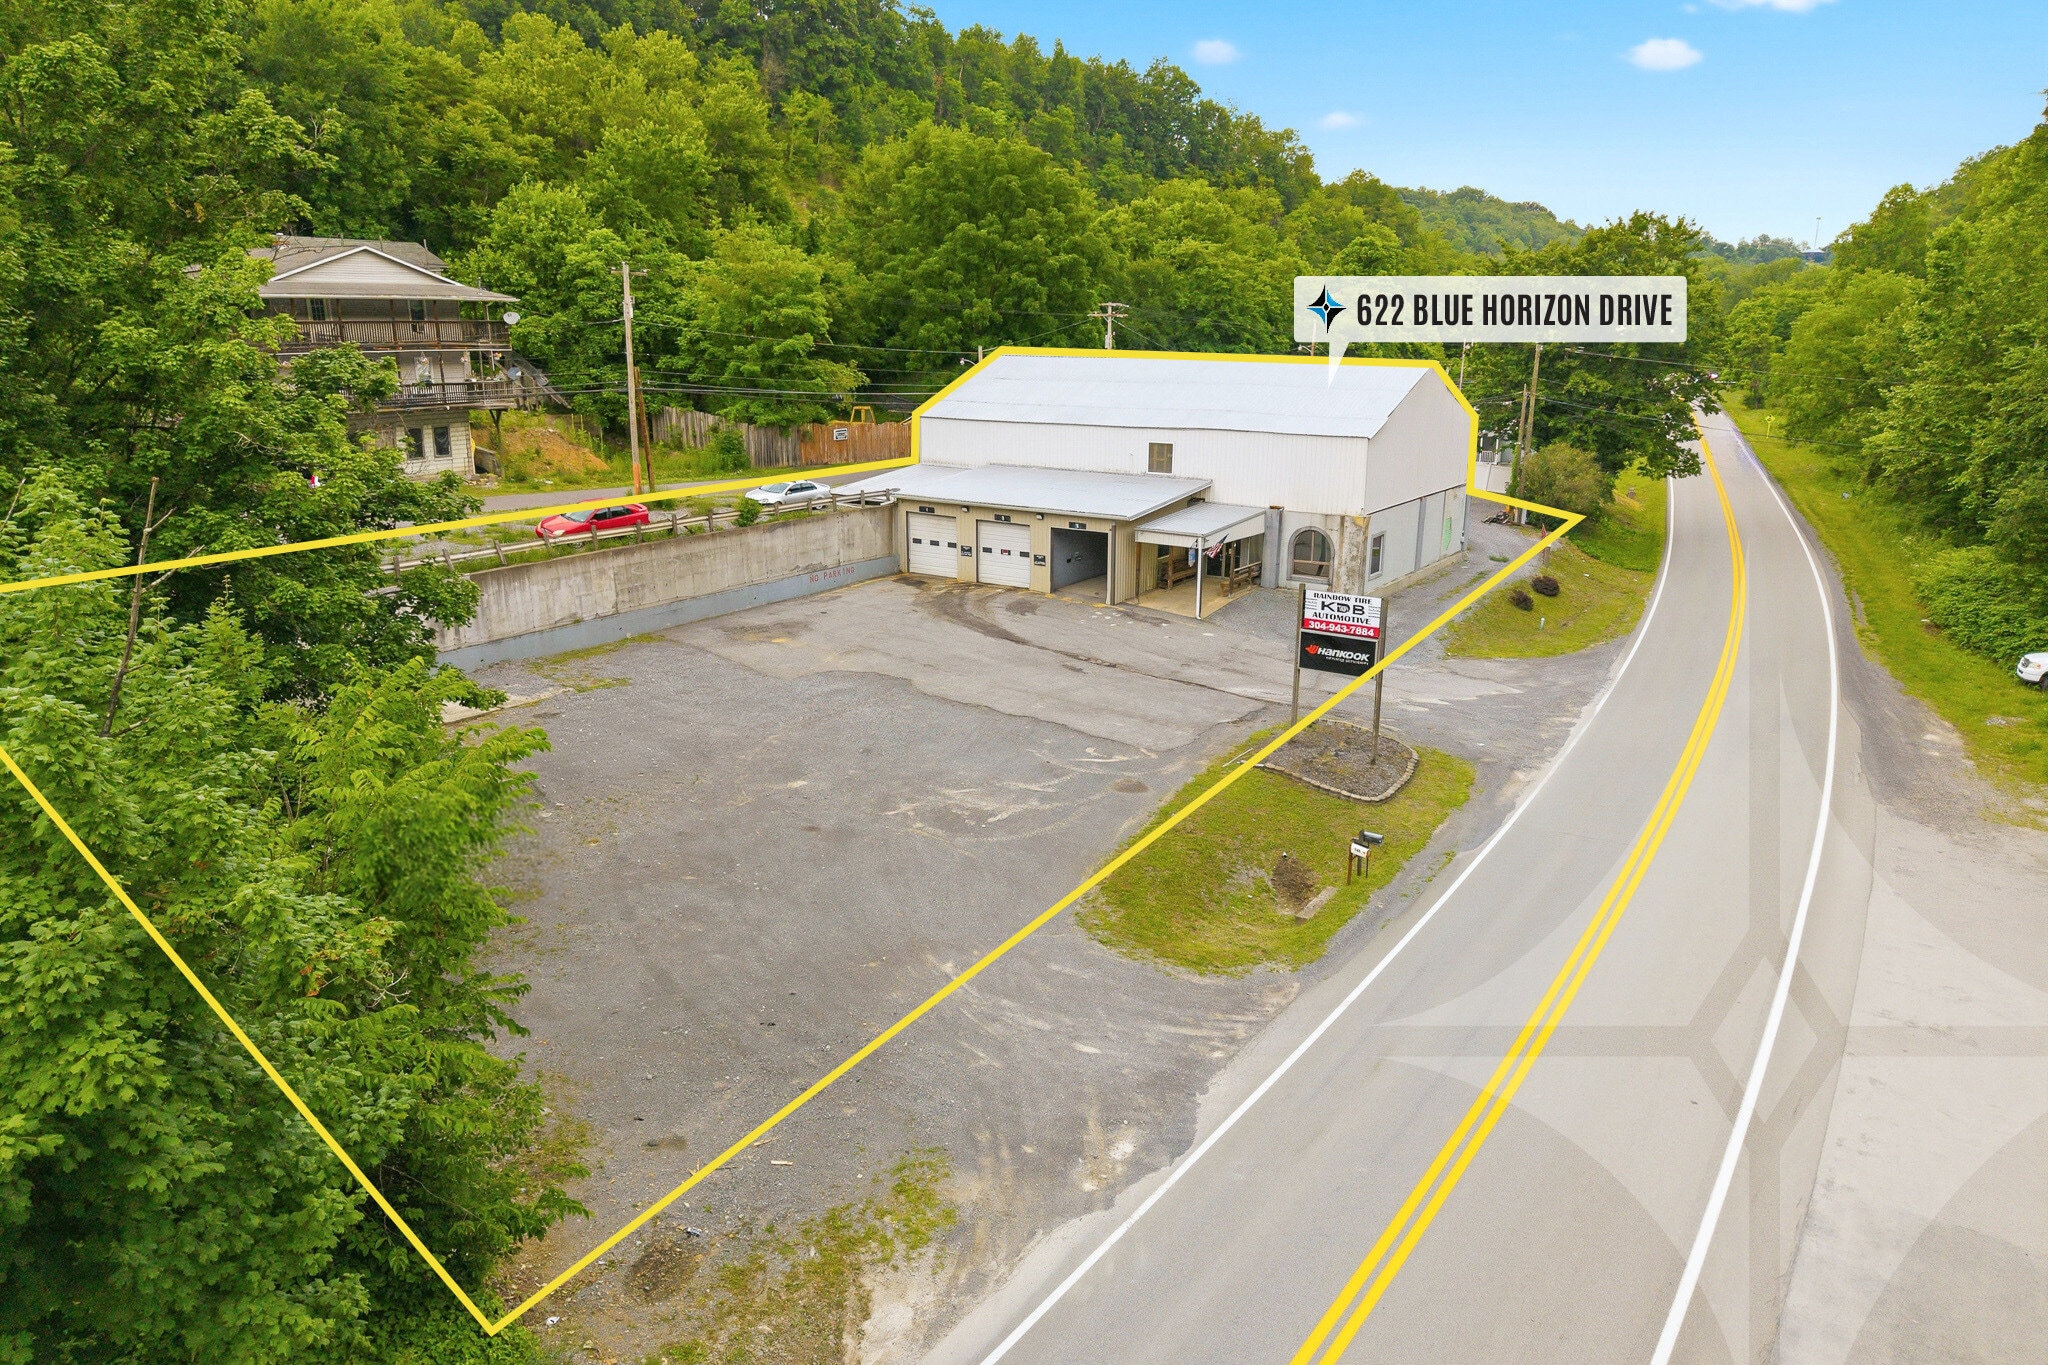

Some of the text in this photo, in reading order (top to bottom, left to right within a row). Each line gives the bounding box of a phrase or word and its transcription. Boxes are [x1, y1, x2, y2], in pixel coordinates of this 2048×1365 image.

[809, 567, 855, 583] NO PARKING
[1313, 593, 1373, 605] RAINBOW TIRE
[1321, 601, 1365, 615] KDB
[1312, 612, 1371, 625] AUTOMOTIVE
[1308, 621, 1374, 636] 304-943-7884
